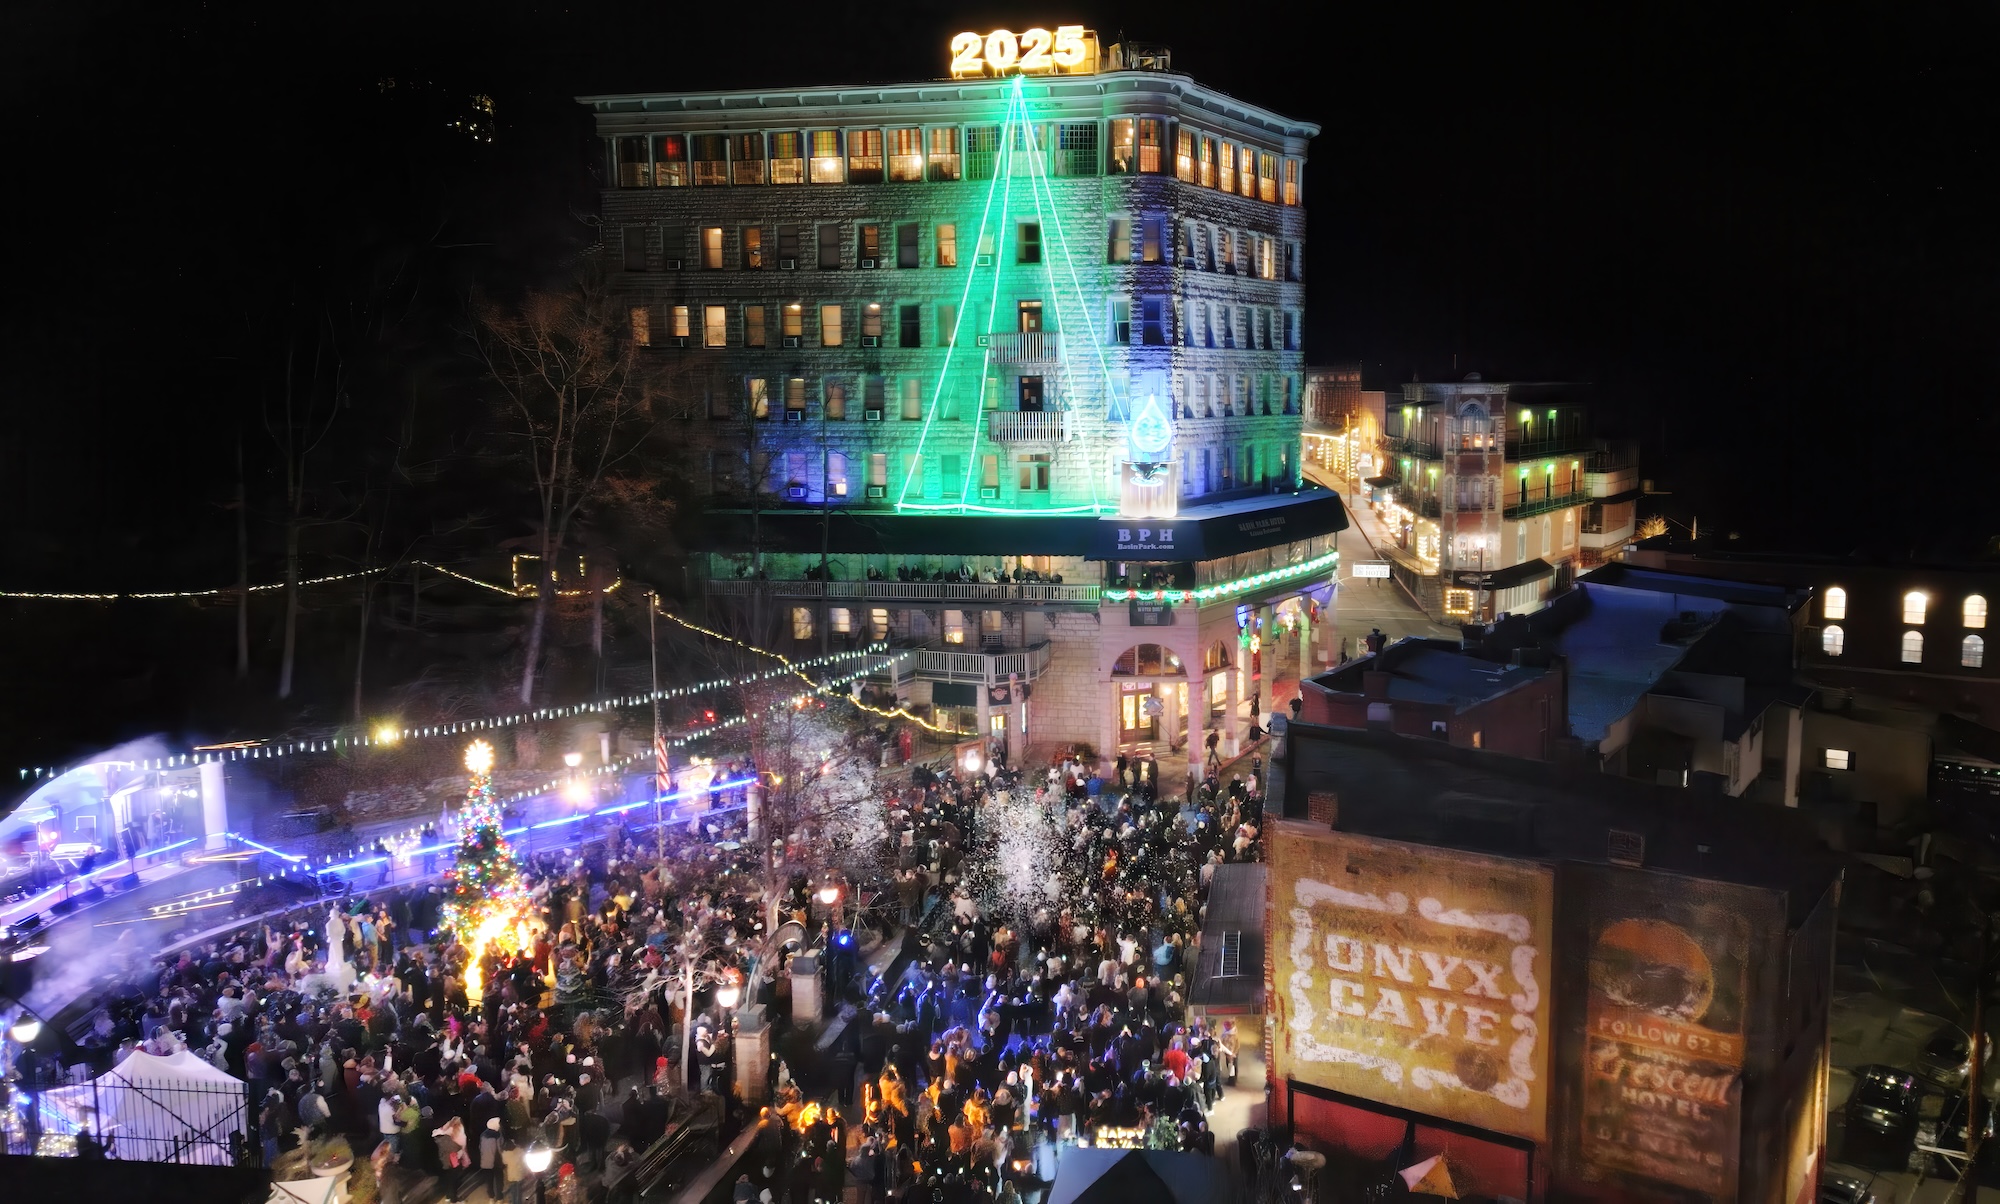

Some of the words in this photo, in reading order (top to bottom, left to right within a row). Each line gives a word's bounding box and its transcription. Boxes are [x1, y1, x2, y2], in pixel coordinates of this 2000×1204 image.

[950, 25, 1087, 72] 2025
[1326, 934, 1505, 999] ONYX
[1329, 978, 1502, 1046] CAVE
[1598, 1017, 1681, 1046] FOLLOW
[1620, 1085, 1712, 1122] HOTEL
[1098, 1127, 1145, 1140] HAPPY
